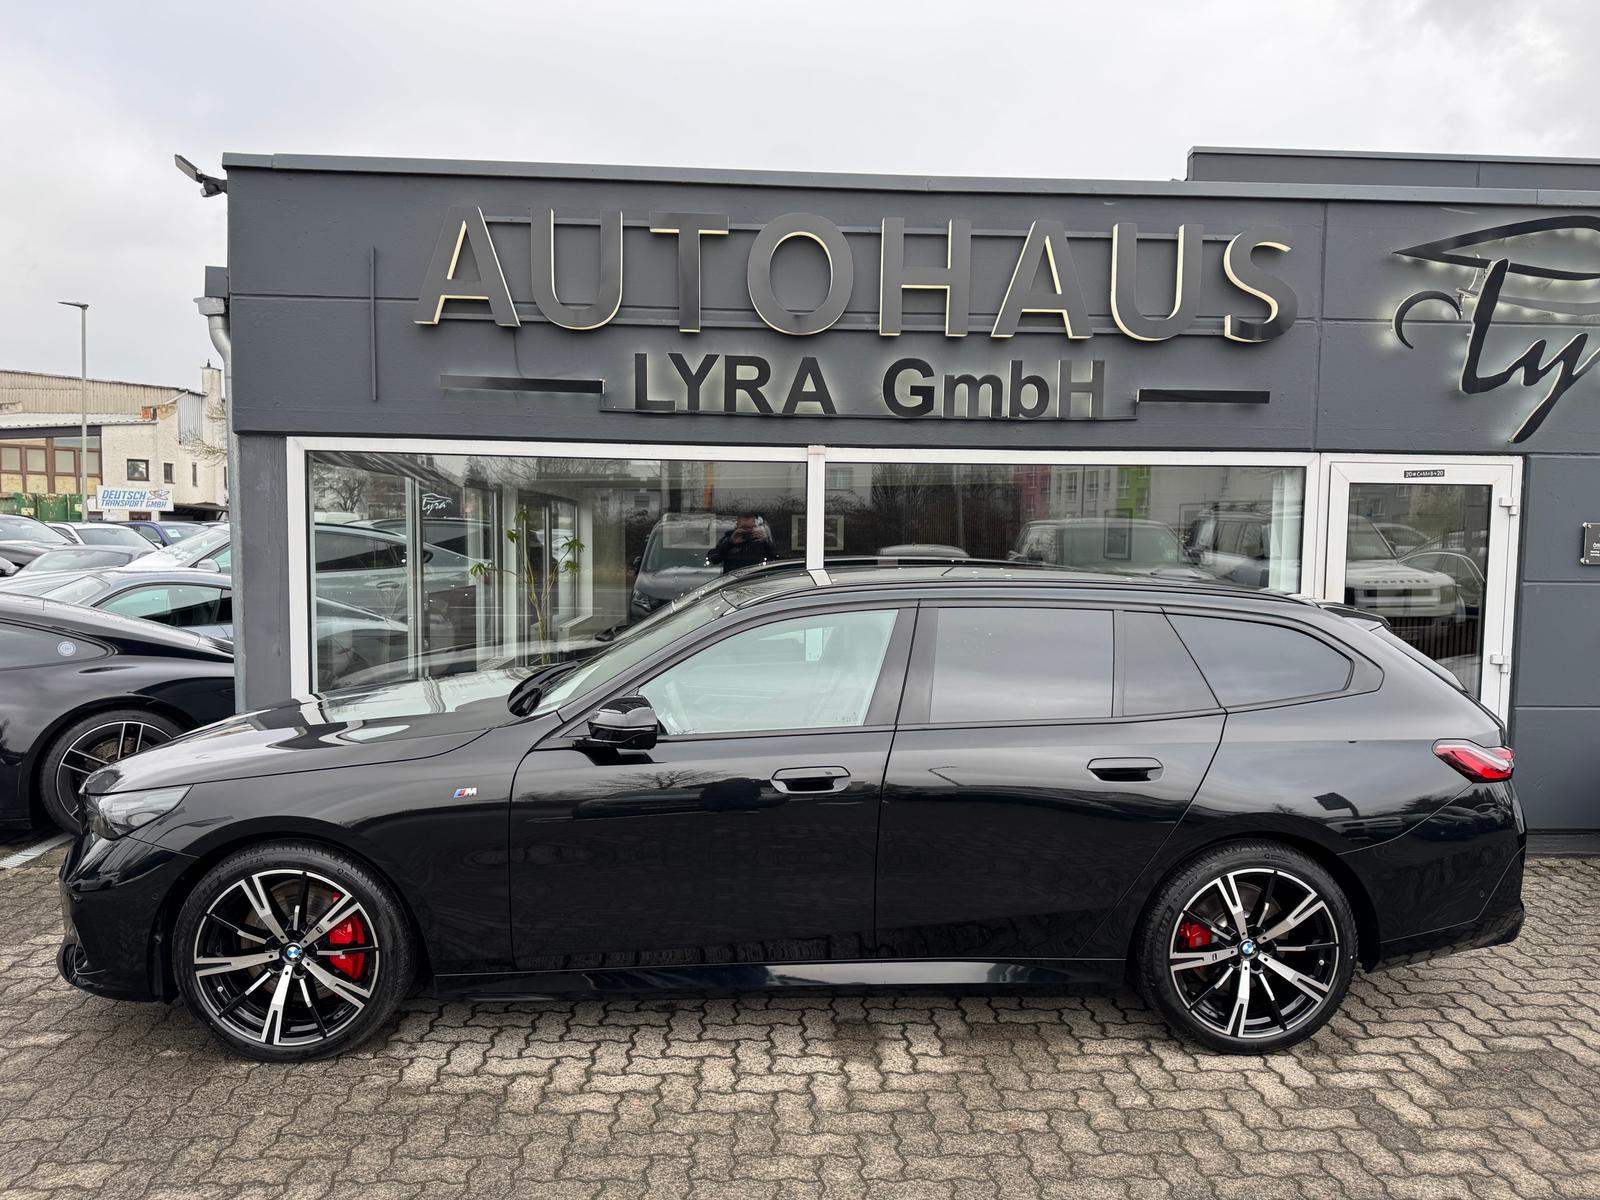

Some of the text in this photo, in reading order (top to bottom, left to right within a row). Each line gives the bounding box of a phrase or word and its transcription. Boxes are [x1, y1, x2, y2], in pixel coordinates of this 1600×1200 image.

[413, 205, 1298, 343] AUTOHAUS
[1392, 257, 1600, 443] Ly
[634, 352, 1105, 419] LYRA GmbH
[101, 499, 144, 507] TRANSPORT
[102, 490, 146, 500] DEUTSCH
